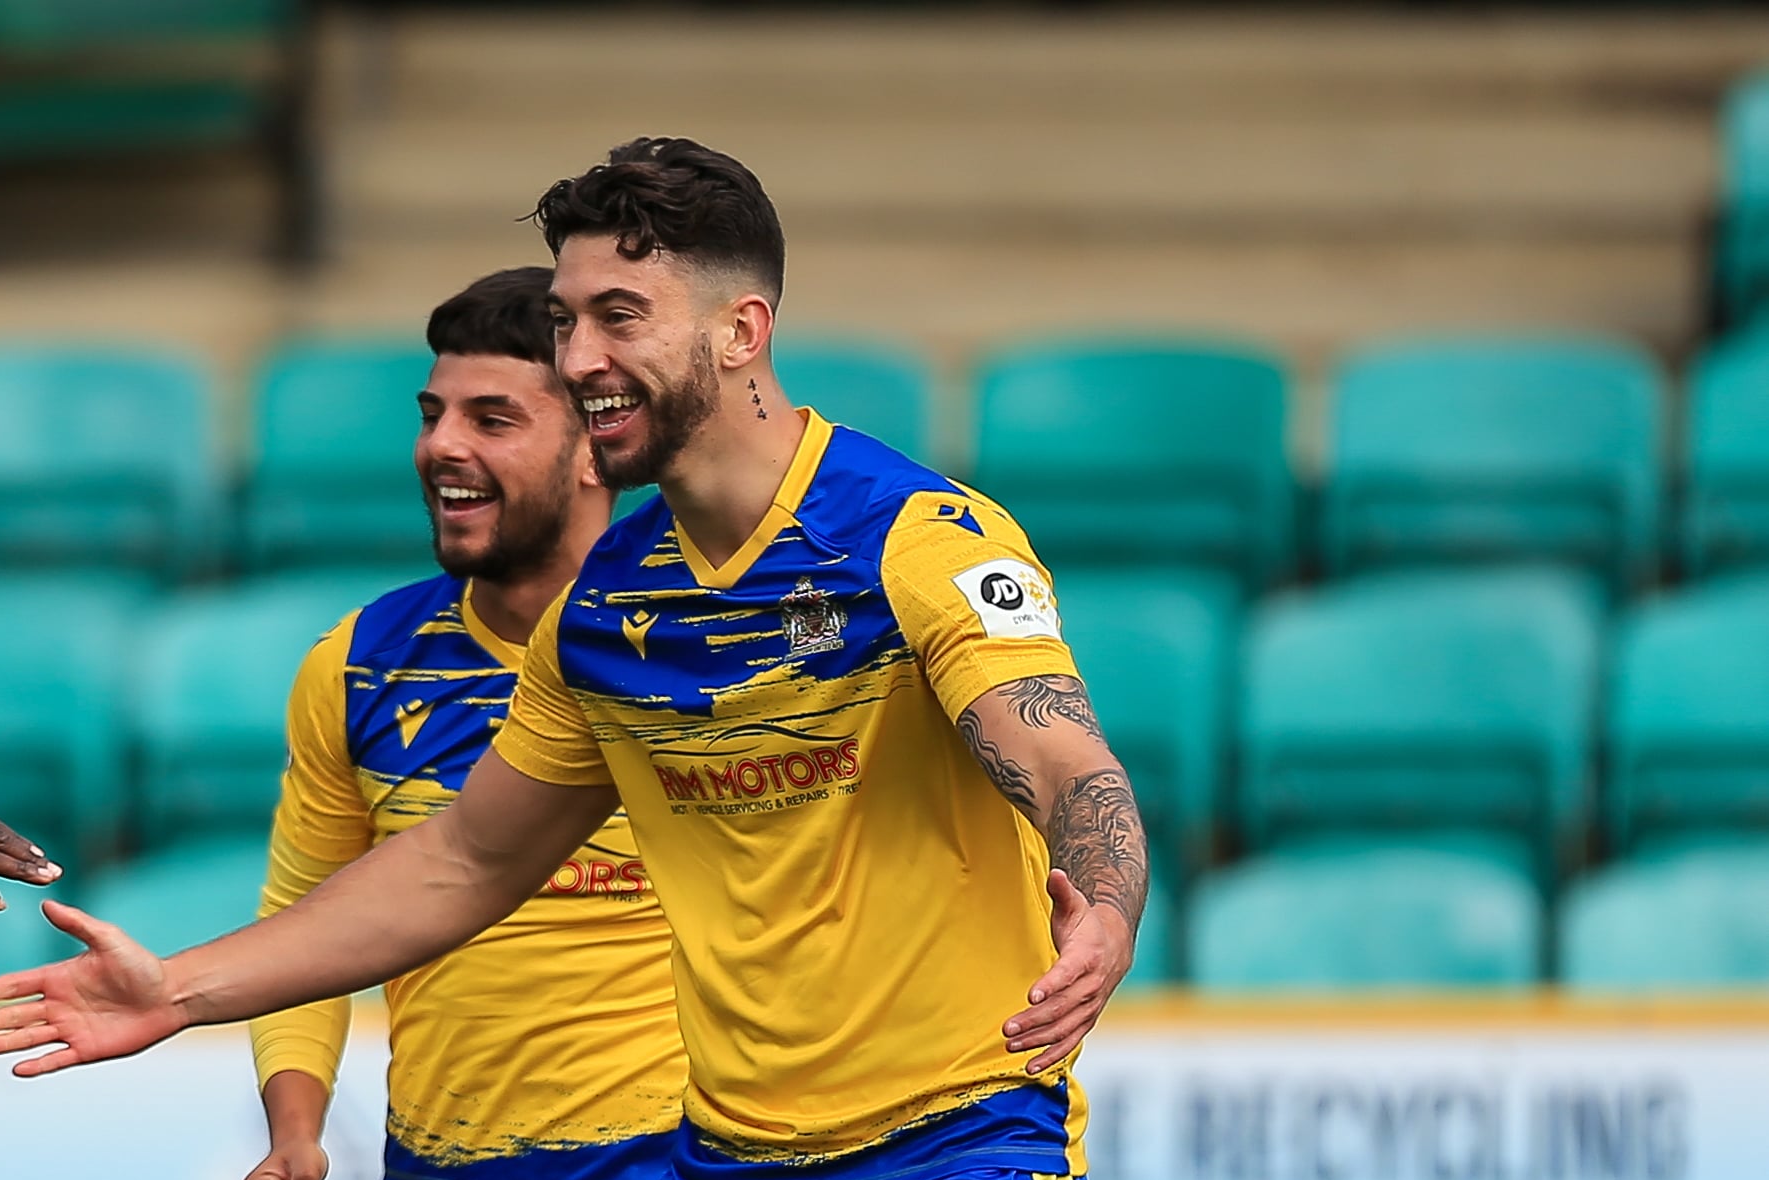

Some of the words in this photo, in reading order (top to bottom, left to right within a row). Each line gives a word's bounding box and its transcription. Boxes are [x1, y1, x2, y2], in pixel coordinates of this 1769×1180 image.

[990, 578, 1021, 605] JD
[704, 738, 859, 800] MOTORS
[725, 798, 774, 815] SERVICING
[775, 798, 784, 810] &
[786, 788, 830, 807] REPAIRS
